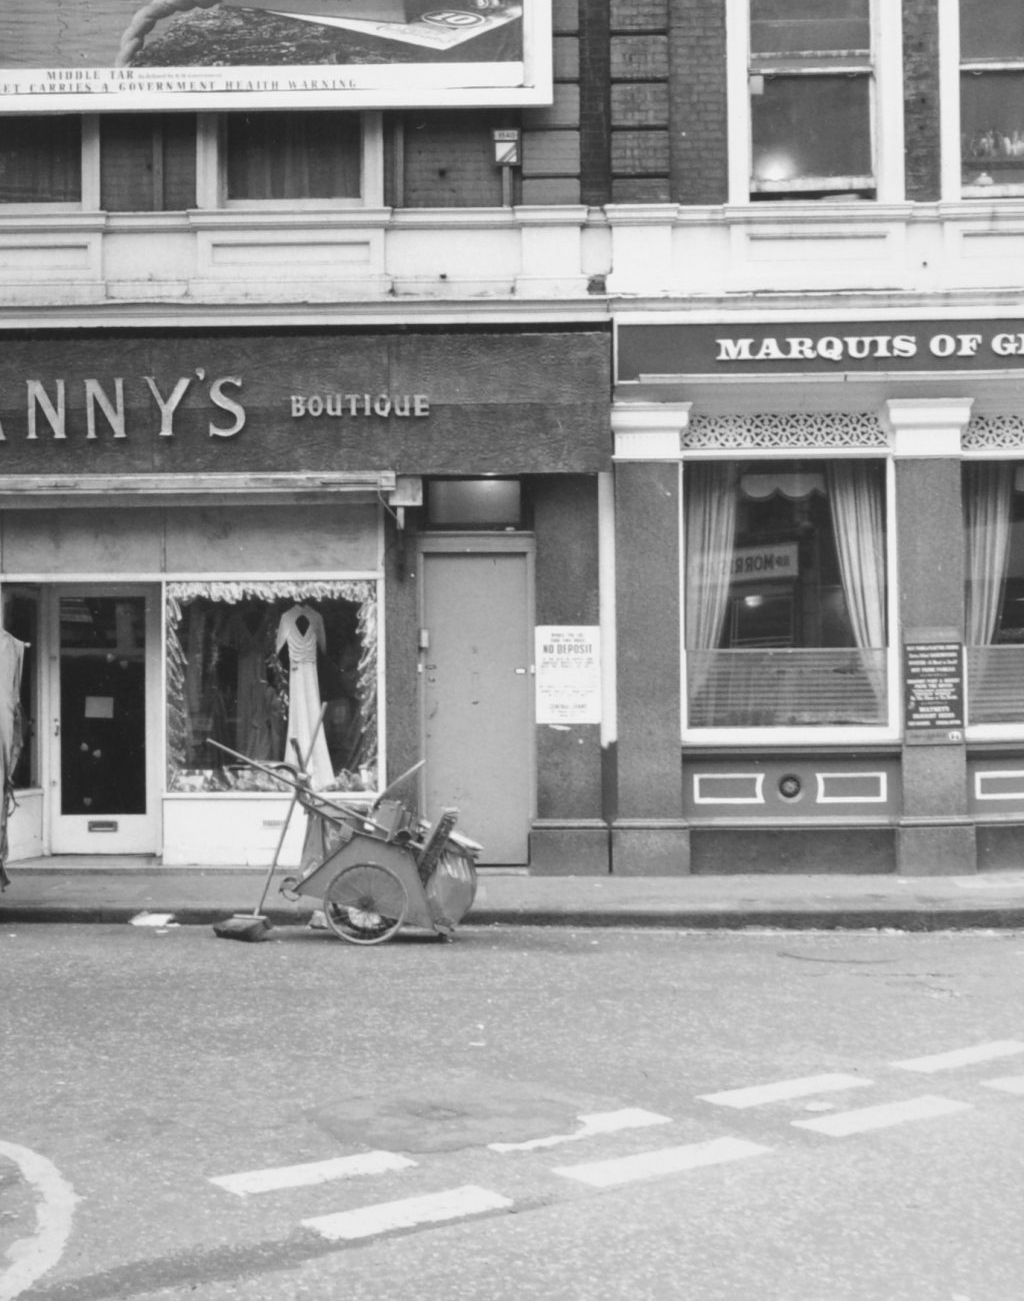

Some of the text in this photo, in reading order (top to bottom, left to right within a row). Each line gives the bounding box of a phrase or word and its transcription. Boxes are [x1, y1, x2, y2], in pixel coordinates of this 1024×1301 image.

[427, 12, 478, 25] 10
[47, 71, 101, 80] MIDDLE
[110, 70, 135, 80] TAR
[29, 83, 92, 93] CARRIES
[101, 83, 110, 92] A
[118, 81, 216, 92] GOVERNMENT
[288, 79, 357, 90] WARNING
[715, 335, 918, 361] MARQUIS
[929, 334, 983, 357] OF
[290, 393, 431, 419] BOUTIQUE
[543, 644, 593, 654] NO DEPOSIT
